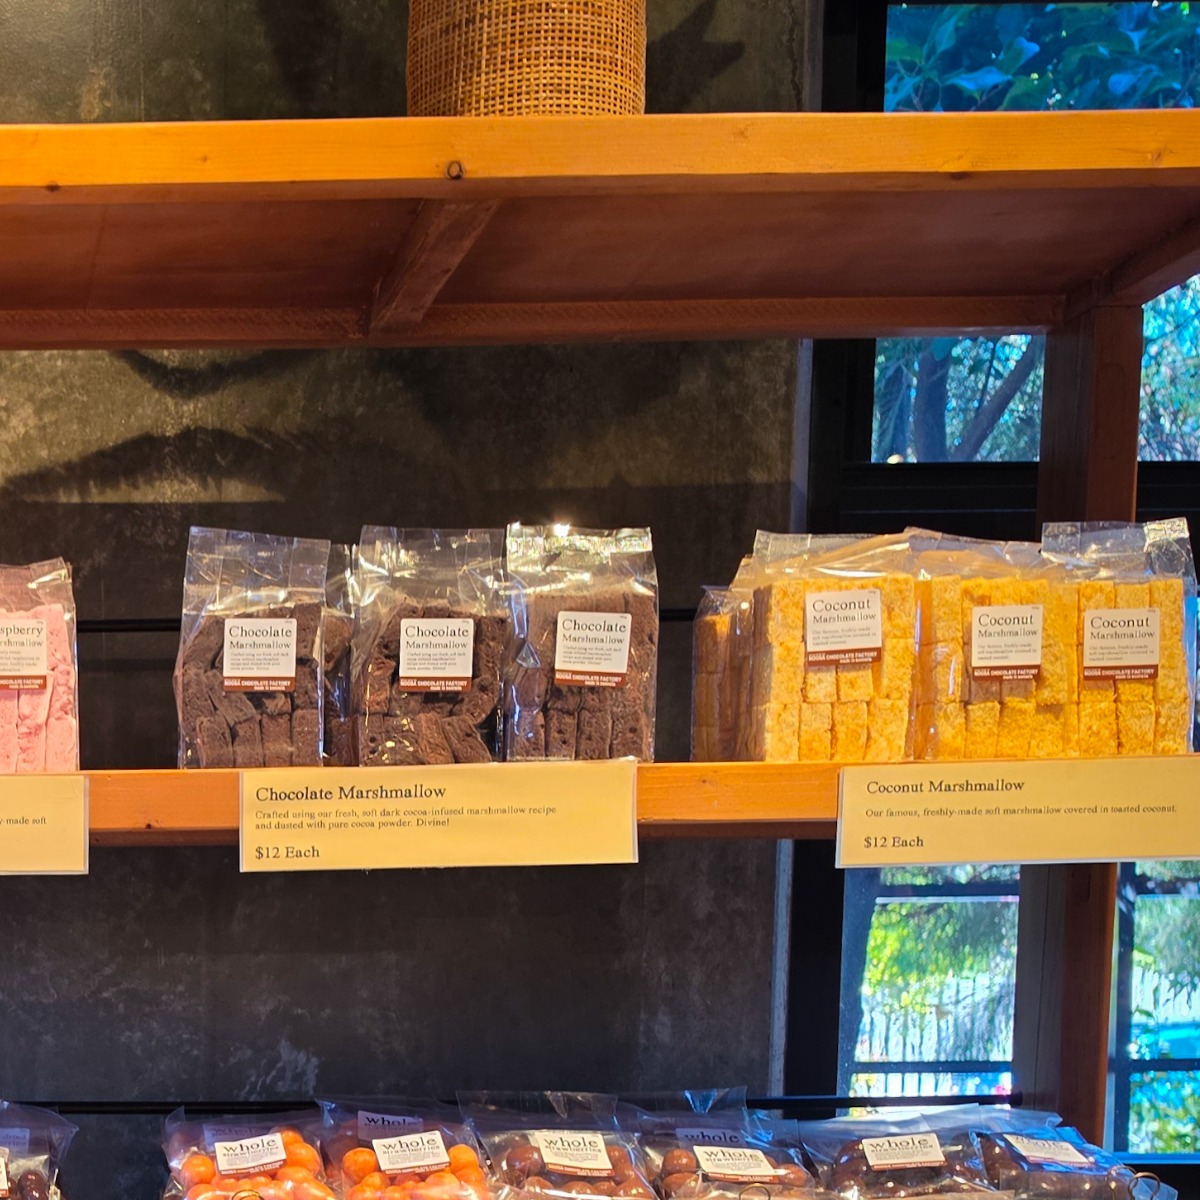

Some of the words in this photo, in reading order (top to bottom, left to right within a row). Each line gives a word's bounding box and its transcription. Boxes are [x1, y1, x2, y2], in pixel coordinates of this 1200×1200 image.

[978, 613, 1033, 627] Coconut
[1090, 616, 1149, 628] Coconut
[228, 625, 292, 637] Chocolate
[405, 625, 468, 637] Chocolate
[978, 628, 1038, 637] Marshmallow
[1090, 630, 1155, 639] Marshmallow
[229, 640, 291, 649] Marshmallow
[406, 640, 468, 649] Marshmallow
[866, 781, 924, 794] Coconut
[928, 778, 1025, 792] Marshmallow
[255, 786, 333, 801] Chocolate
[338, 784, 446, 799] Marshmallow
[255, 810, 290, 820] Crafted
[292, 810, 315, 821] using
[362, 809, 378, 818] soft
[380, 808, 401, 817] dark
[403, 806, 464, 817] cocoa-infused
[467, 806, 526, 815] marshmallow
[528, 806, 557, 815] recipe
[865, 808, 883, 817] Our
[923, 806, 982, 818] freshly-made
[985, 806, 1000, 815] soft
[1003, 805, 1062, 815] marshmallow
[1063, 804, 1097, 814] covered
[1100, 805, 1108, 813] in
[1110, 804, 1140, 813] toasted
[31, 816, 46, 824] soft
[255, 821, 272, 829] and
[274, 820, 303, 829] dusted
[306, 819, 325, 829] with
[328, 821, 348, 830] pure
[863, 835, 887, 848] $12
[891, 835, 924, 847] Each
[255, 846, 280, 860] $12
[285, 845, 319, 858] Each
[382, 1135, 437, 1151] whole
[544, 1136, 599, 1150] whole
